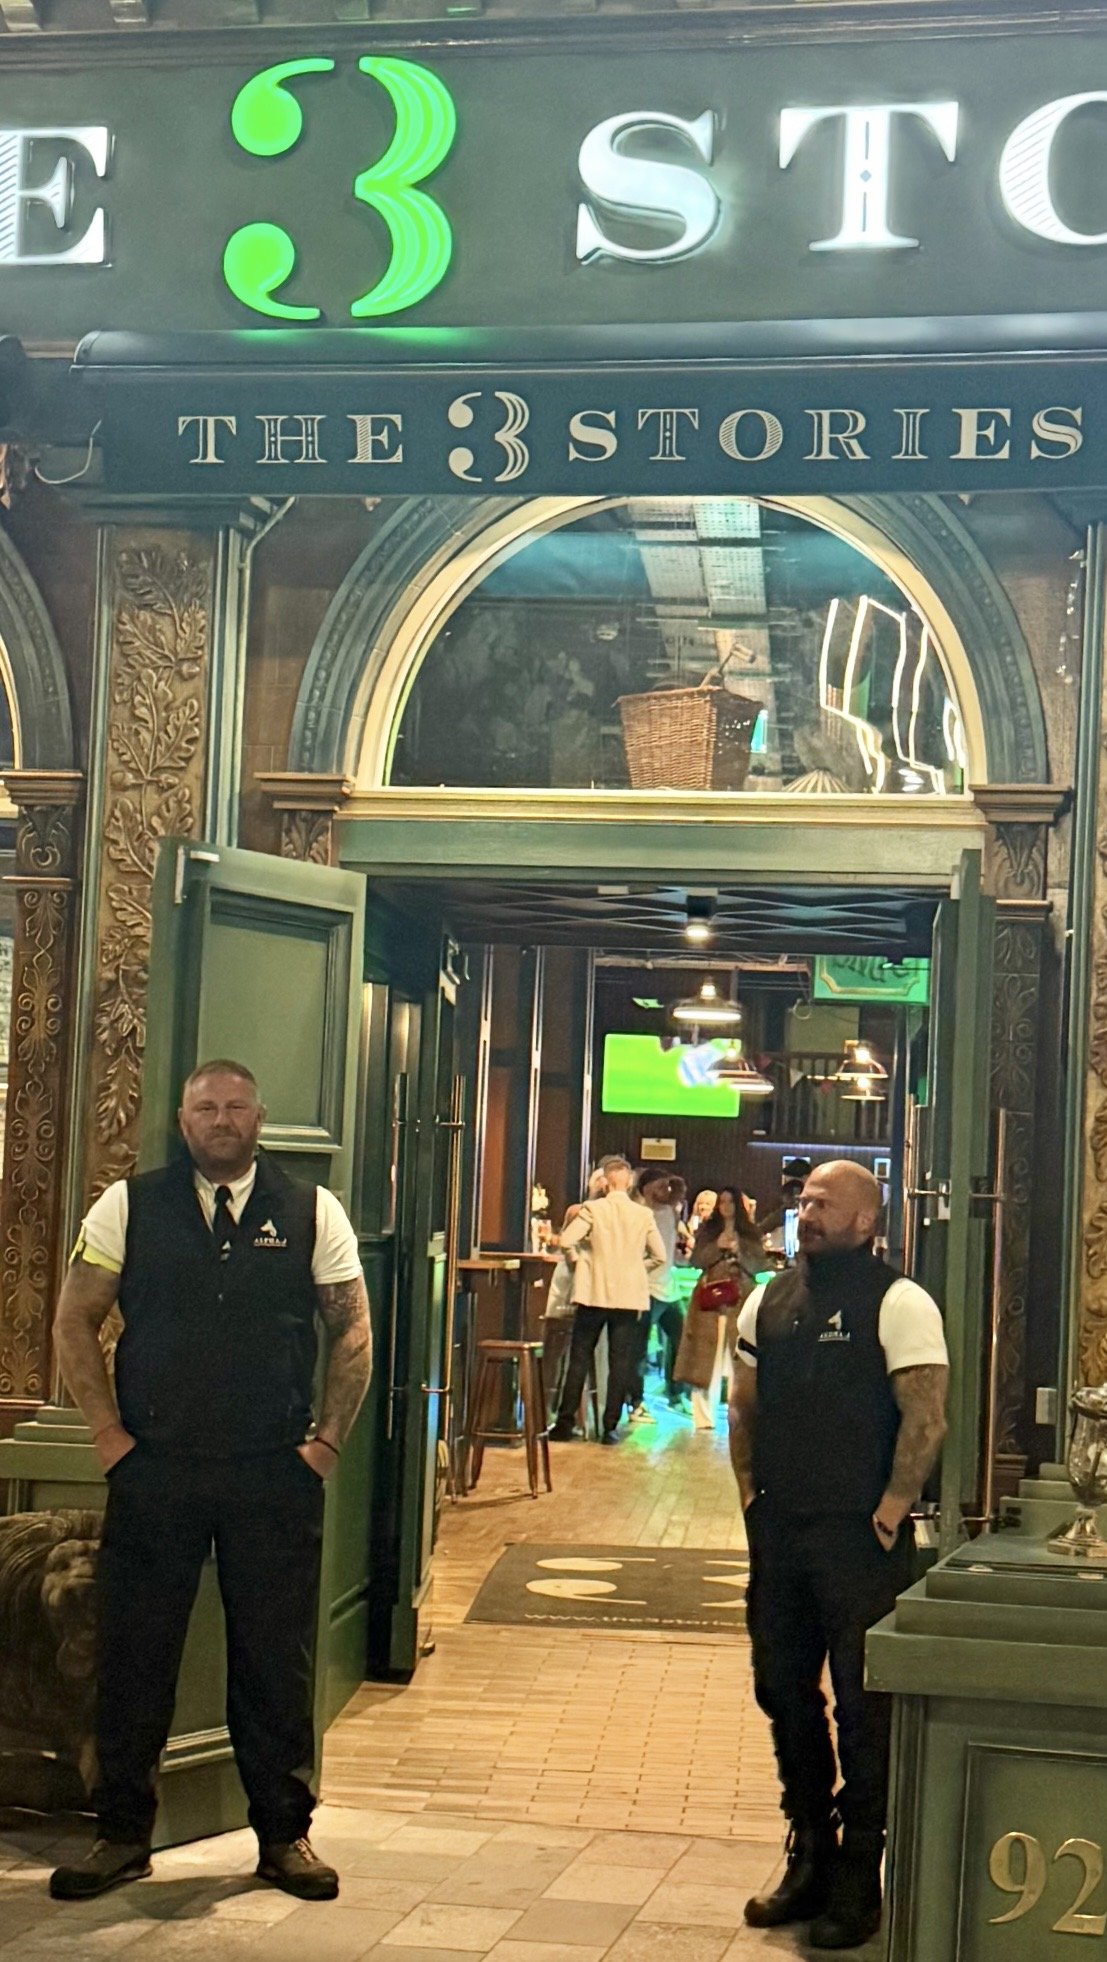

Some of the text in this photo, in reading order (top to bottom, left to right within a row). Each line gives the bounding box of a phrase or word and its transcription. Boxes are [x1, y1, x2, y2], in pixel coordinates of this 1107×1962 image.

[224, 56, 456, 320] 3
[577, 91, 1107, 264] STO
[177, 391, 1085, 483] THE 3 STORIES
[988, 1831, 1107, 1936] 92
